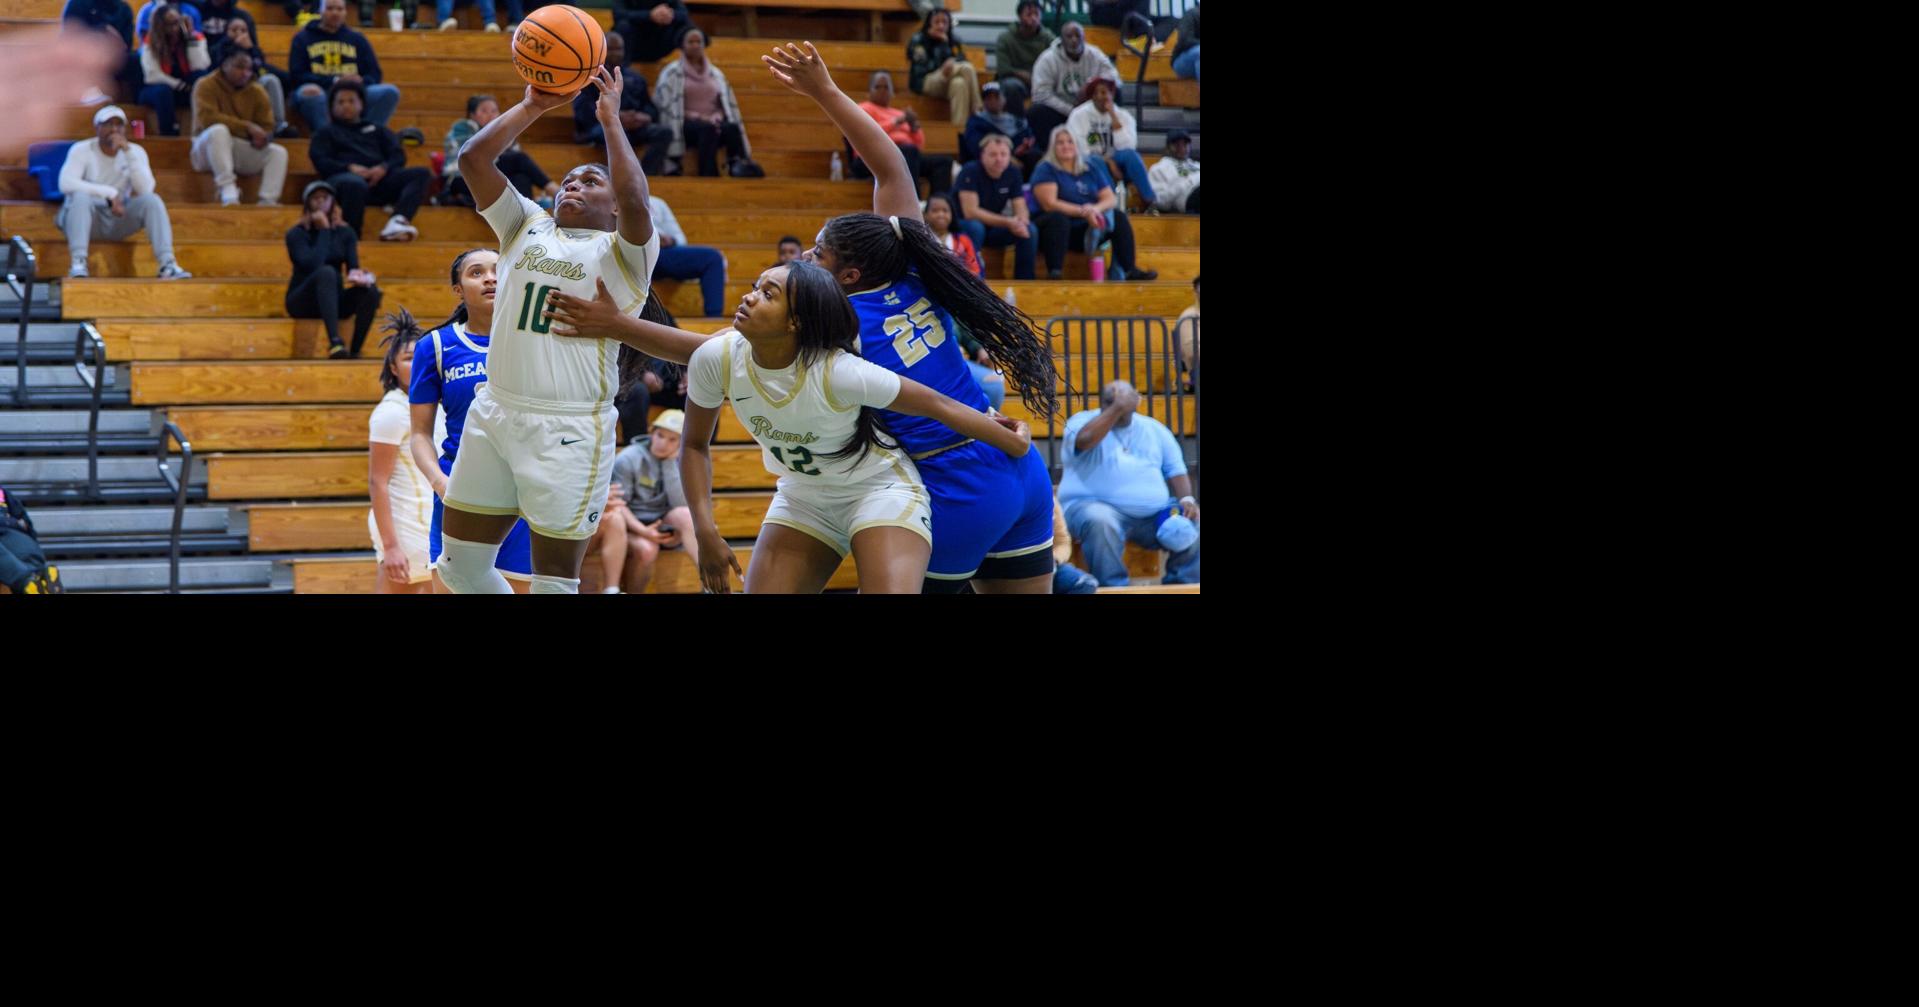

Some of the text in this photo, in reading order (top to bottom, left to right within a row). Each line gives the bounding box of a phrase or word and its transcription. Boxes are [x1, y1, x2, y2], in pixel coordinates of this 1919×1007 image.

[514, 243, 587, 281] Rams
[517, 281, 561, 334] 10
[882, 296, 946, 368] 25
[750, 415, 820, 444] Rams
[770, 445, 822, 476] 12
